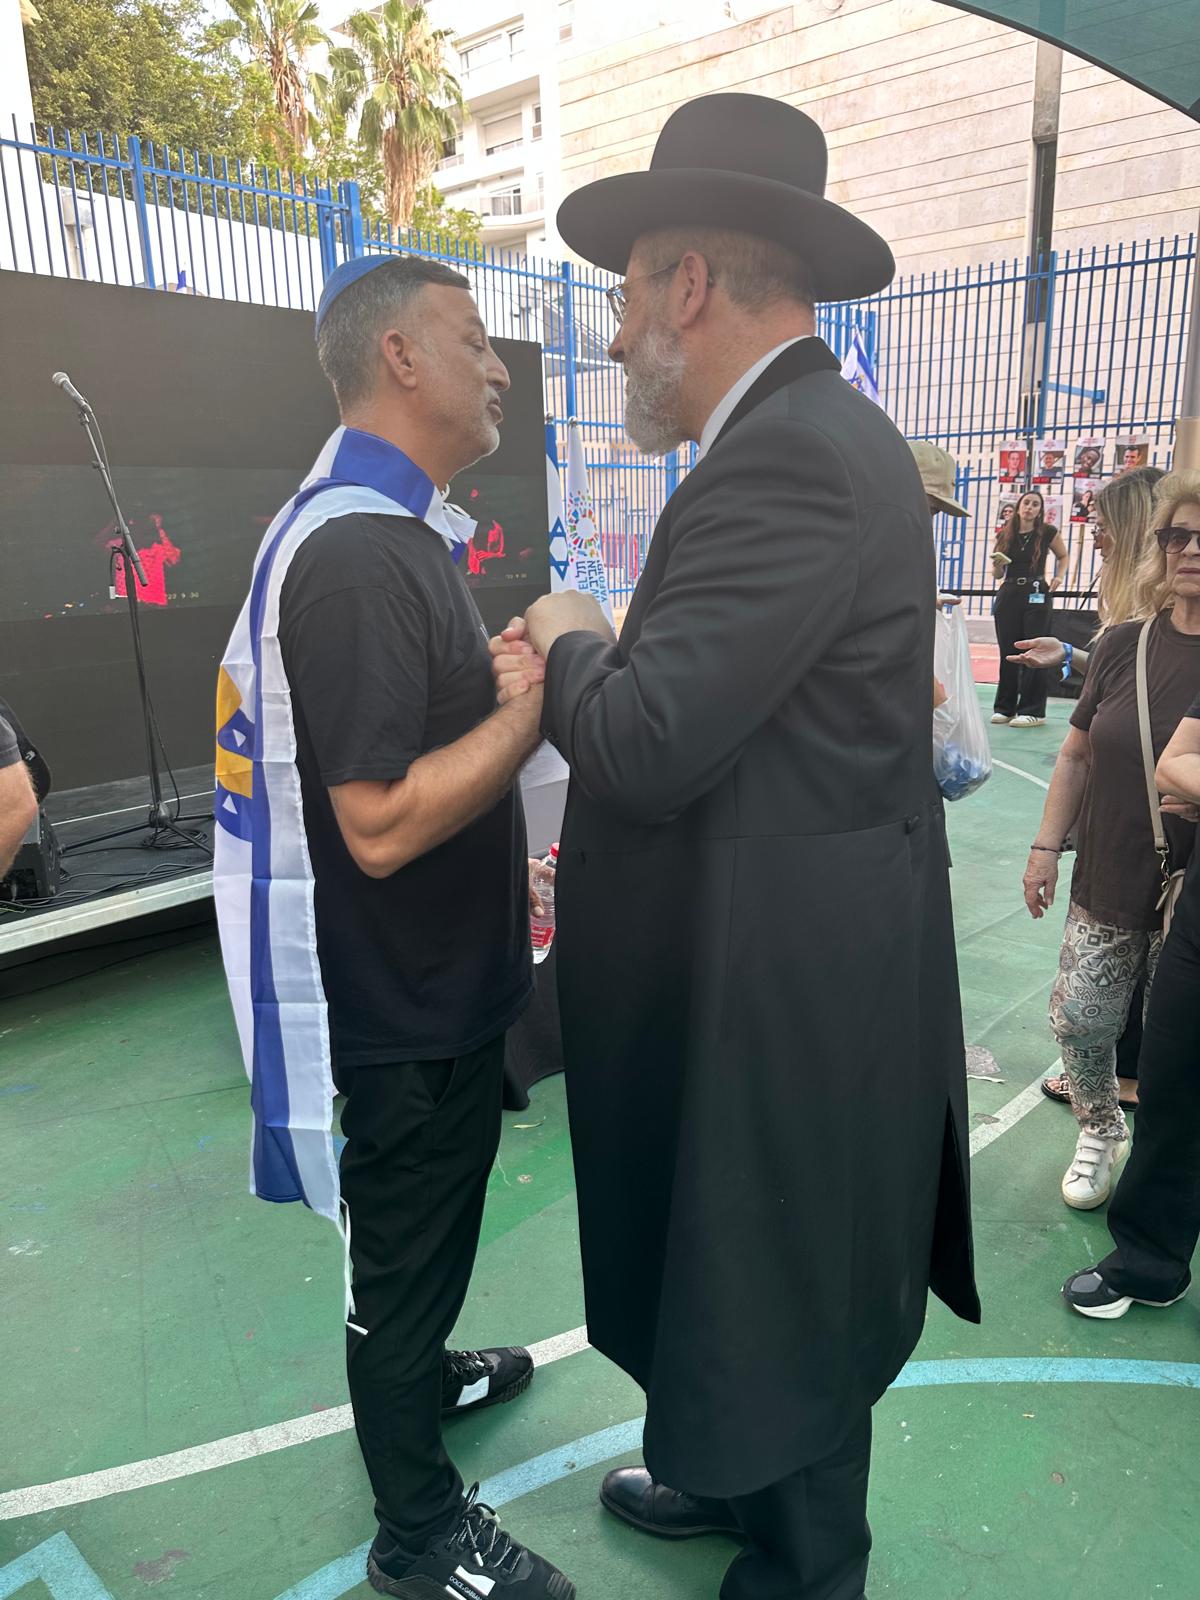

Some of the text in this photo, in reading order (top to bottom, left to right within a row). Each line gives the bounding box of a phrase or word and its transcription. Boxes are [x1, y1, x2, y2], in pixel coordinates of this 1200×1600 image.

[576, 561, 586, 578] תל
[587, 560, 598, 587] אביב
[577, 577, 588, 590] EL
[599, 576, 607, 602] YAFO
